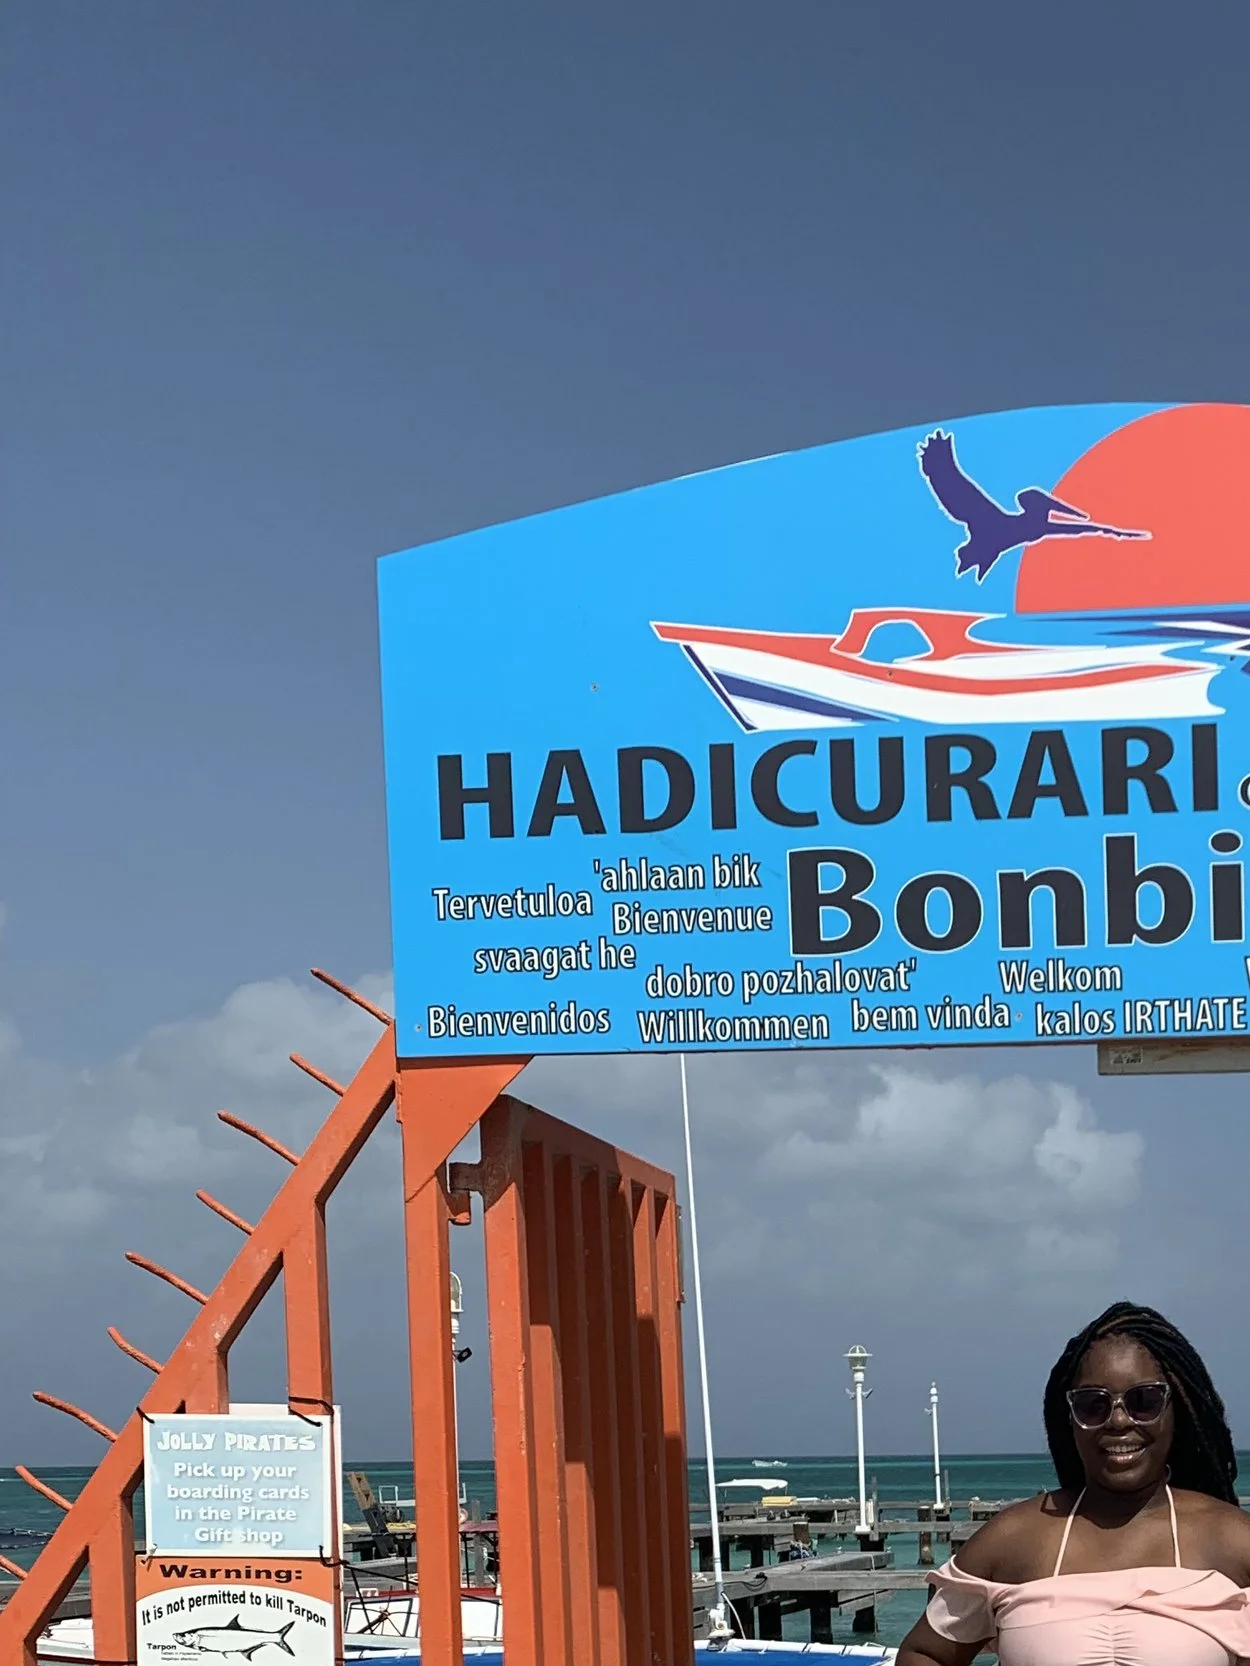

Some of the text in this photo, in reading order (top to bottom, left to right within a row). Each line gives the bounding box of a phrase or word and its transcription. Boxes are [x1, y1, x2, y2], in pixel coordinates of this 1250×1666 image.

[436, 723, 1219, 839] HADICURARI
[712, 854, 761, 889] bik
[432, 883, 593, 920] Tervetuloa
[612, 901, 773, 935] Bienvenue
[474, 936, 636, 979] svaagat he
[646, 957, 919, 1003] dobro pozhalovat'
[998, 958, 1123, 993] Welkom
[428, 1000, 611, 1038] Bienvenidos
[637, 1006, 831, 1043] Willkommen
[851, 994, 1011, 1032] bem vinda
[1035, 996, 1247, 1036] kalos IRTHATE
[157, 1431, 316, 1451] JOLLY PIRATES
[174, 1462, 297, 1480] Pick up your
[167, 1484, 310, 1502] boarding cards
[175, 1506, 297, 1521] in the Pirate
[194, 1527, 233, 1543] Gift
[160, 1564, 303, 1583] Warning:
[142, 1590, 327, 1627] It is not permitted to kill Tarpon
[147, 1642, 177, 1652] Tarpon
